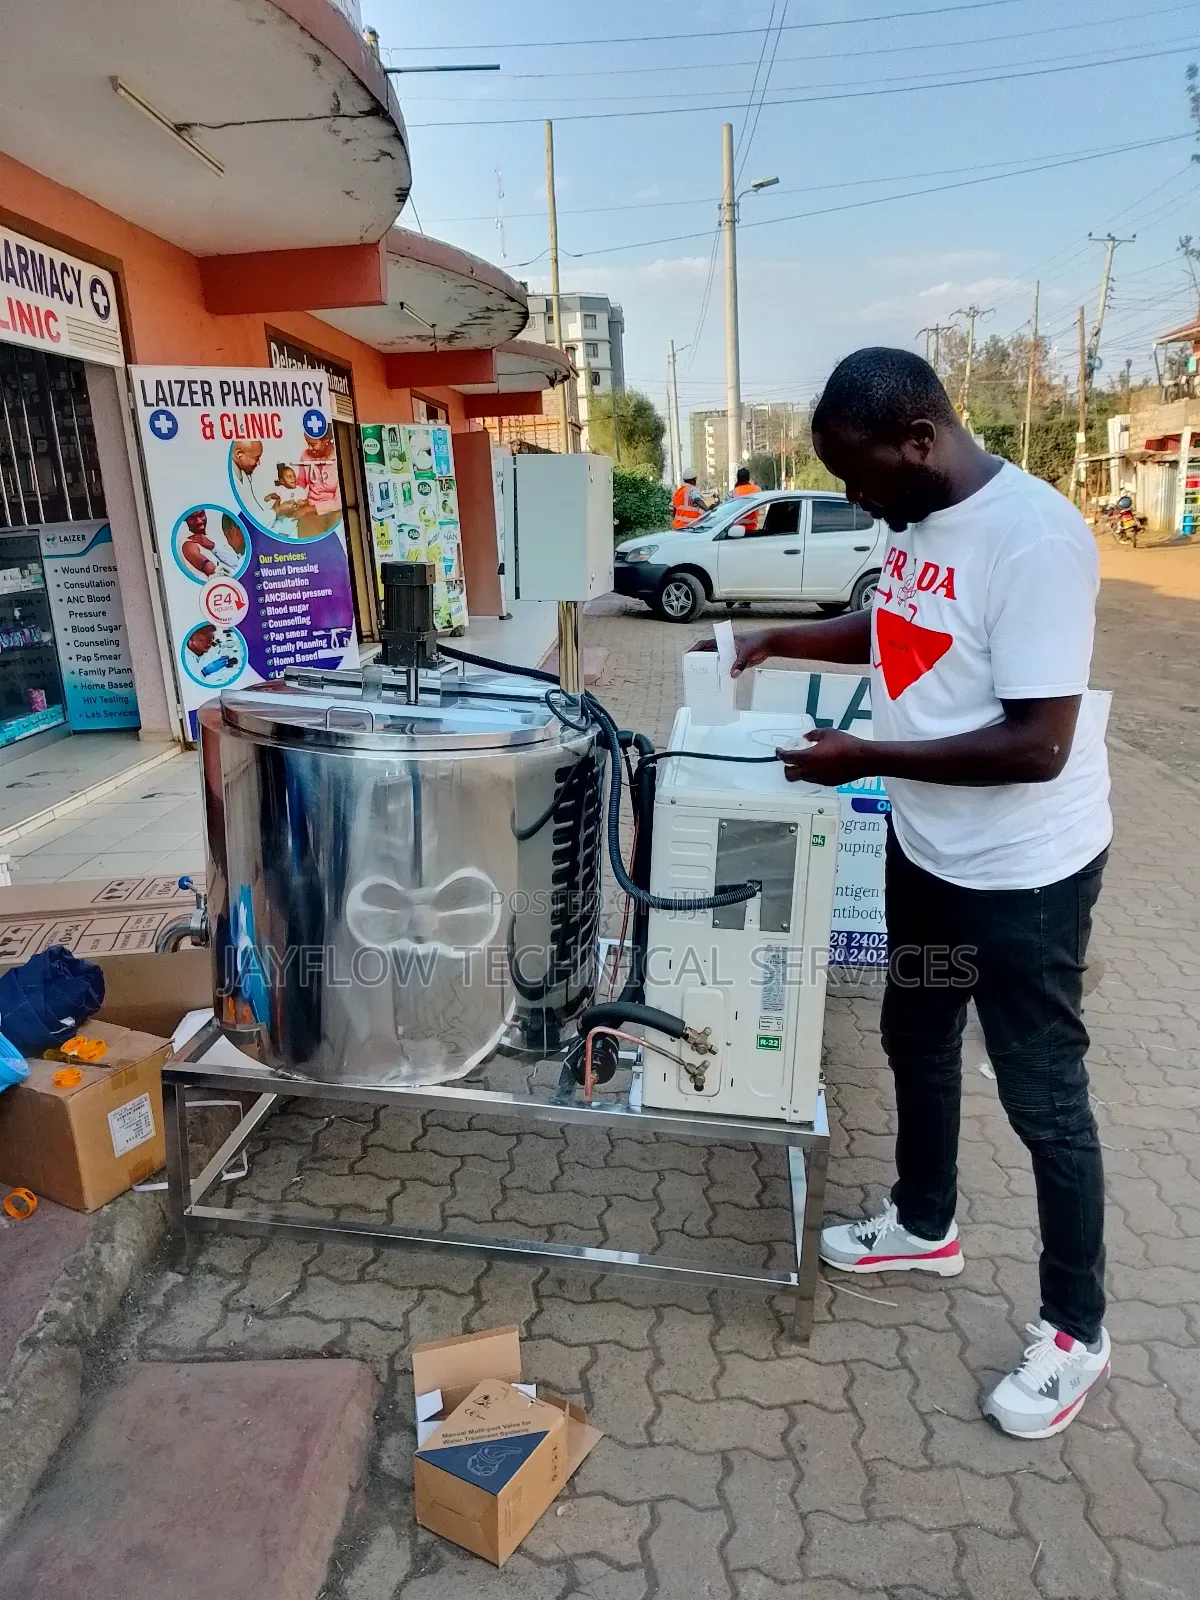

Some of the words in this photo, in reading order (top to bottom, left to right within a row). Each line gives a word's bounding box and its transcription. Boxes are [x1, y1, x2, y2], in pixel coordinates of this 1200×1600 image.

[0, 239, 83, 308] ARMACY
[0, 296, 61, 343] INIC
[140, 379, 213, 408] LAIZER
[220, 381, 323, 407] PHARMACY
[201, 413, 215, 440] &
[219, 413, 283, 440] CLINIC
[59, 534, 86, 542] LAIZER
[259, 554, 272, 564] Our
[273, 552, 307, 562] Services:
[61, 565, 90, 574] Wound
[261, 566, 286, 577] Wound
[287, 563, 319, 574] Dressing
[883, 547, 957, 600] PRDA
[64, 579, 116, 589] Consultation
[263, 578, 309, 590] Consultation
[67, 596, 85, 604] ANC
[87, 594, 111, 603] Blood
[213, 593, 232, 606] 24
[302, 588, 332, 600] pressure
[69, 610, 107, 618] Pressure
[267, 605, 288, 616] Blood
[289, 603, 310, 614] sugar
[71, 624, 95, 633] Blood
[97, 624, 122, 633] Sugar
[270, 632, 285, 642] Pap
[285, 629, 308, 639] smear
[74, 638, 120, 647] Counseling
[272, 643, 295, 654] Family
[296, 638, 328, 650] Planning
[76, 654, 92, 663] Pap
[94, 653, 122, 661] Smear
[274, 656, 295, 666] Home
[295, 651, 319, 663] Based
[79, 667, 106, 677] Family
[276, 669, 286, 679] La
[108, 680, 133, 689] Based
[83, 696, 97, 704] HIV
[99, 696, 129, 704] Testing
[85, 710, 101, 719] Lab
[103, 710, 139, 718] Services
[812, 835, 824, 845] ok
[849, 948, 888, 963] 2402
[760, 1039, 779, 1047] R-22
[442, 1430, 467, 1438] Manual
[468, 1425, 500, 1435] Multi-port
[502, 1422, 521, 1430] Valve
[443, 1437, 462, 1445] Water
[465, 1433, 498, 1442] Treatment
[500, 1428, 529, 1437] Systems
